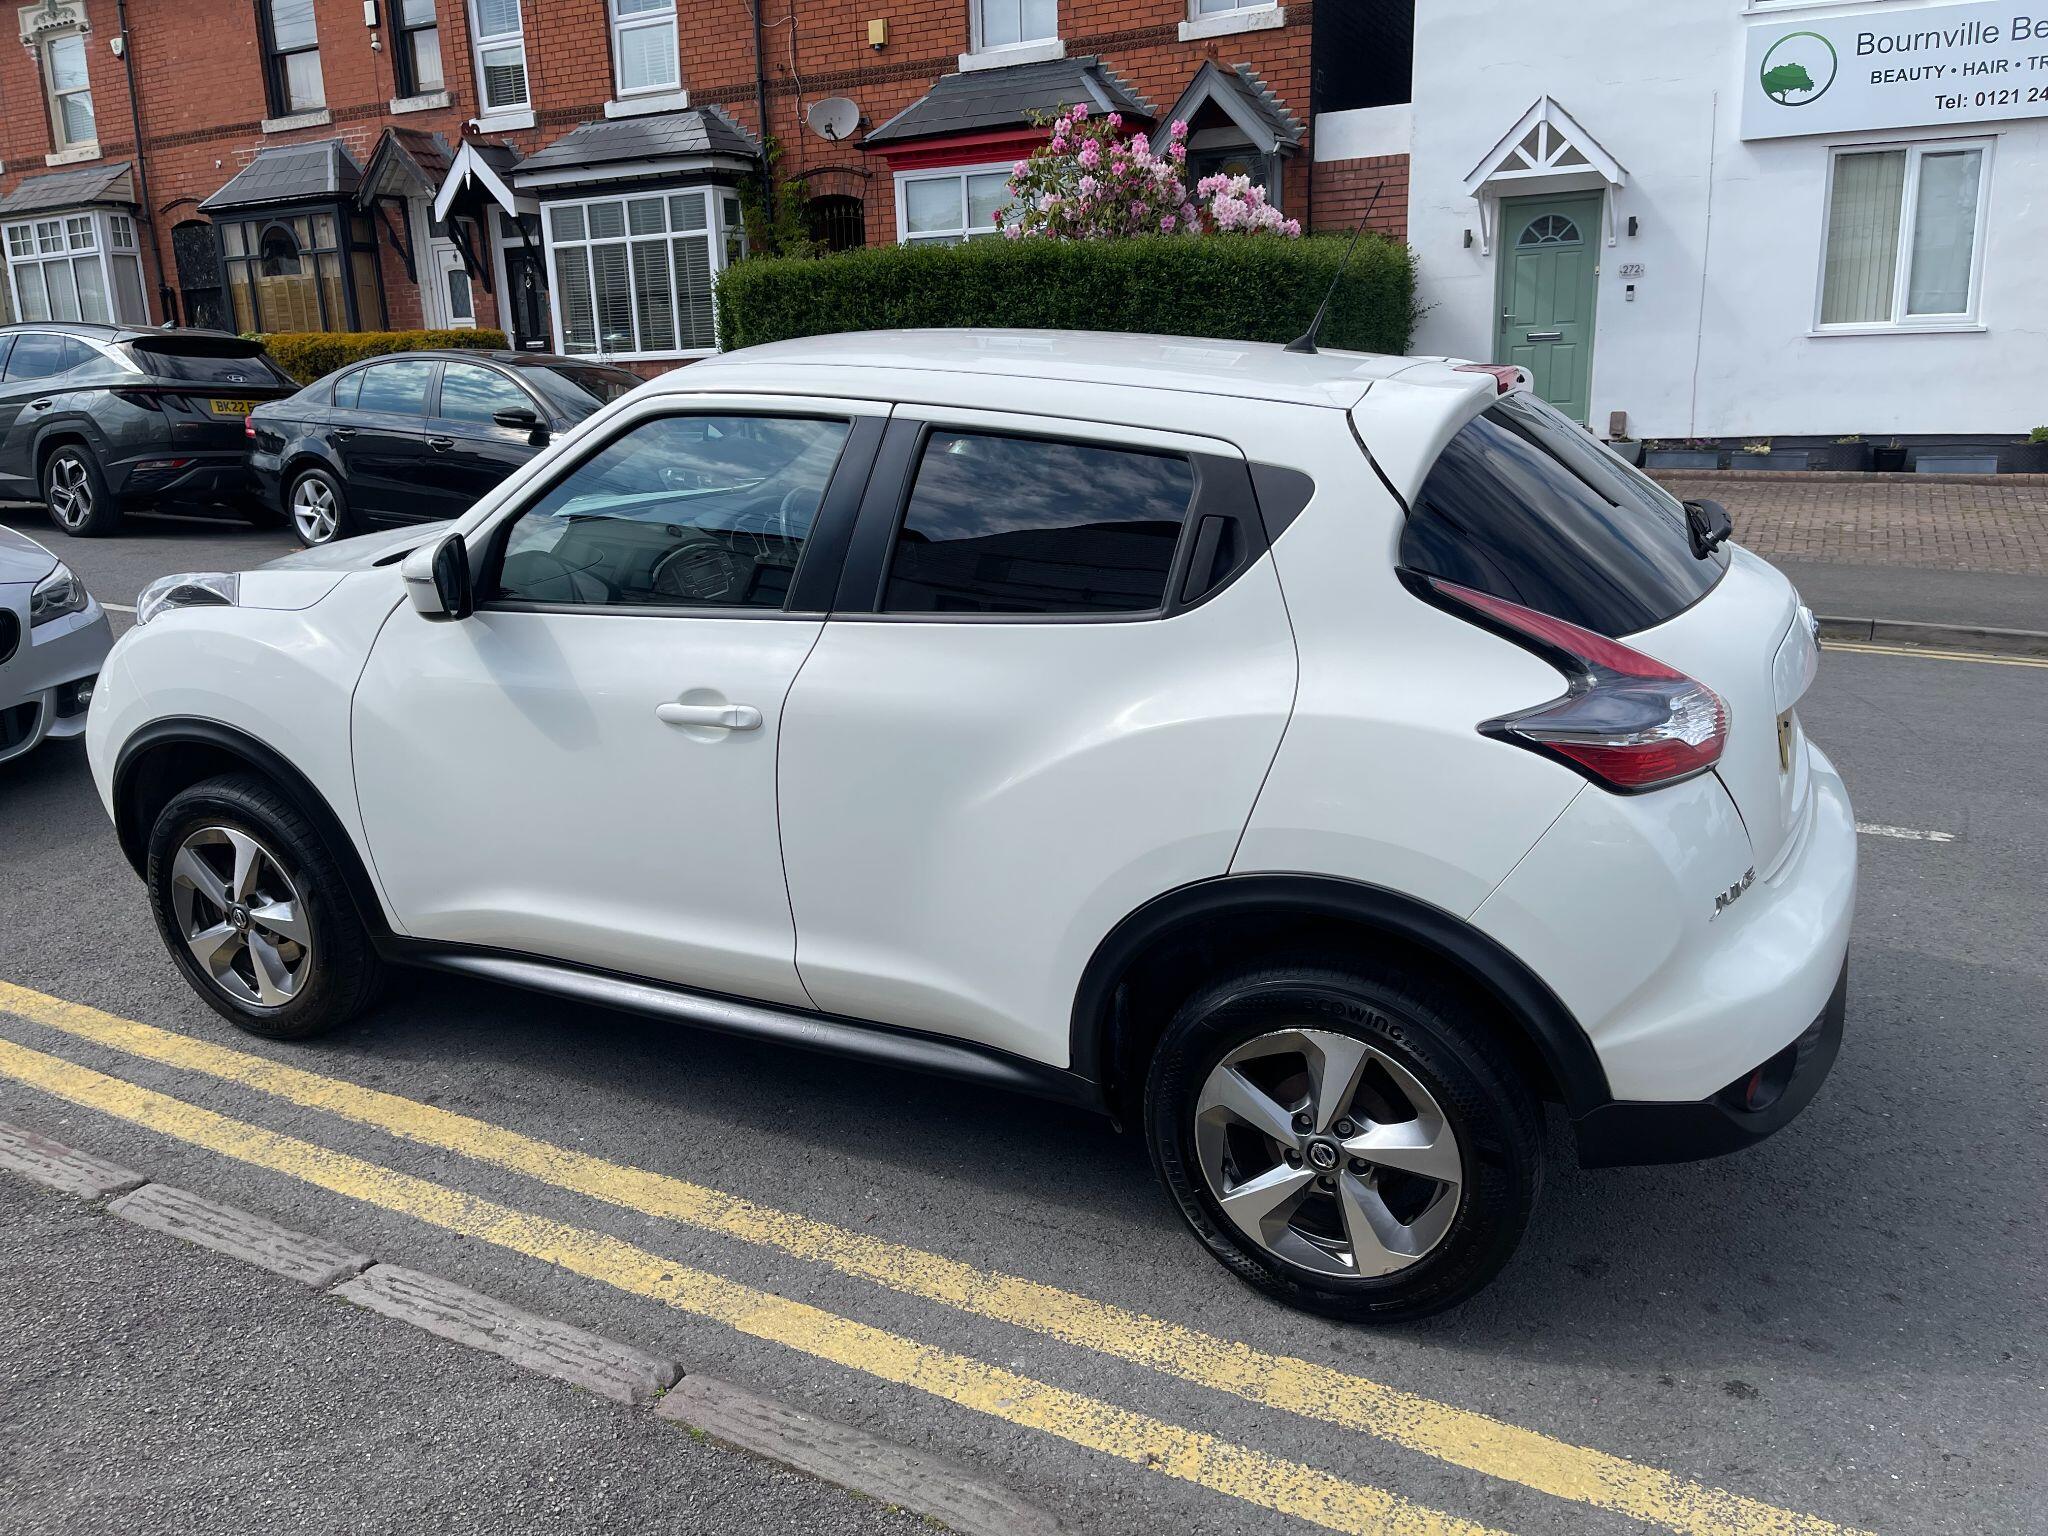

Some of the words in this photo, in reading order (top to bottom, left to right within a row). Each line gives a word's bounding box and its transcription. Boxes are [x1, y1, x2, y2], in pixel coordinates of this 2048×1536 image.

[1856, 20, 2000, 56] Bournville
[2011, 16, 2048, 41] Be
[1870, 64, 1947, 84] BEAUTY
[1962, 59, 2009, 76] HAIR
[1934, 93, 1968, 109] Tel:
[1975, 88, 2019, 107] 0121
[2027, 86, 2048, 103] 24
[1622, 264, 1641, 273] 272
[215, 400, 246, 412] BK22
[1709, 865, 1757, 921] JUKE
